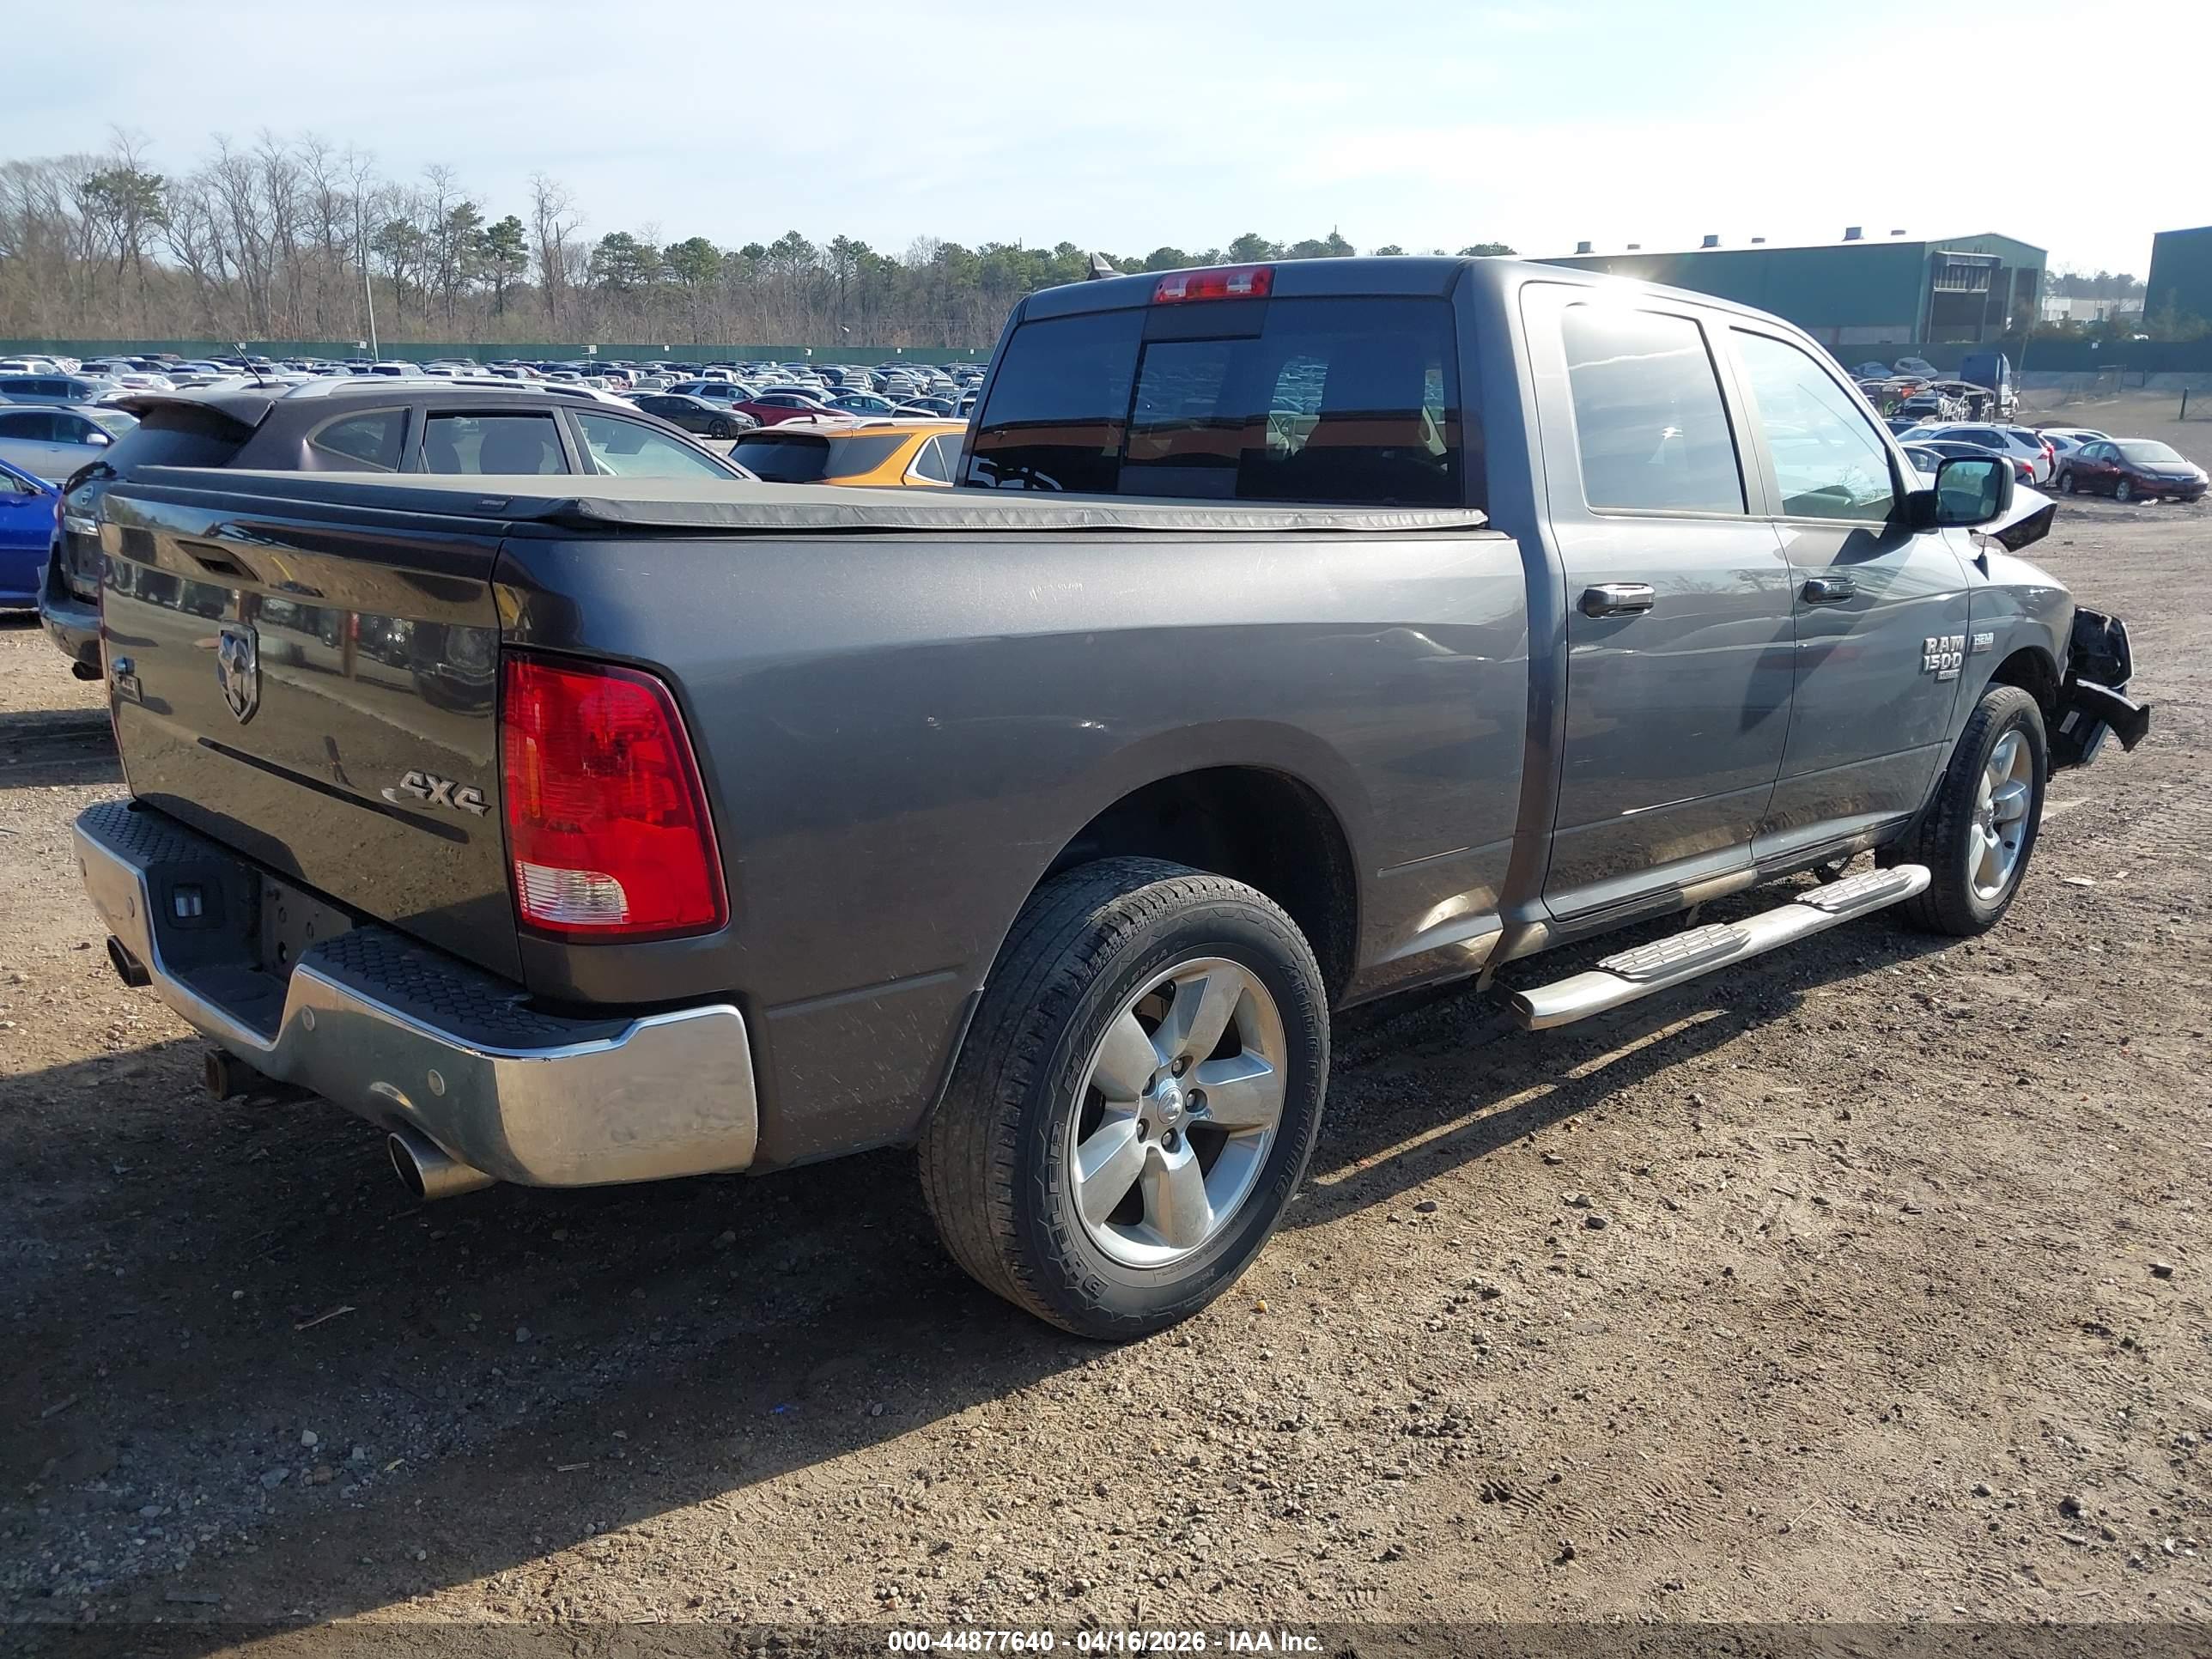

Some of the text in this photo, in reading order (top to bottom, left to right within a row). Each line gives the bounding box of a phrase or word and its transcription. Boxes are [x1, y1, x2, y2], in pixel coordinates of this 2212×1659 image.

[1924, 635, 1965, 653] RAM
[1972, 632, 1994, 645] HEMI
[1923, 653, 1962, 671] 1500
[1277, 961, 1320, 1199] BRIDGESTONE
[1048, 1121, 1109, 1300] DUELER
[1114, 948, 1169, 1006] ALENZA
